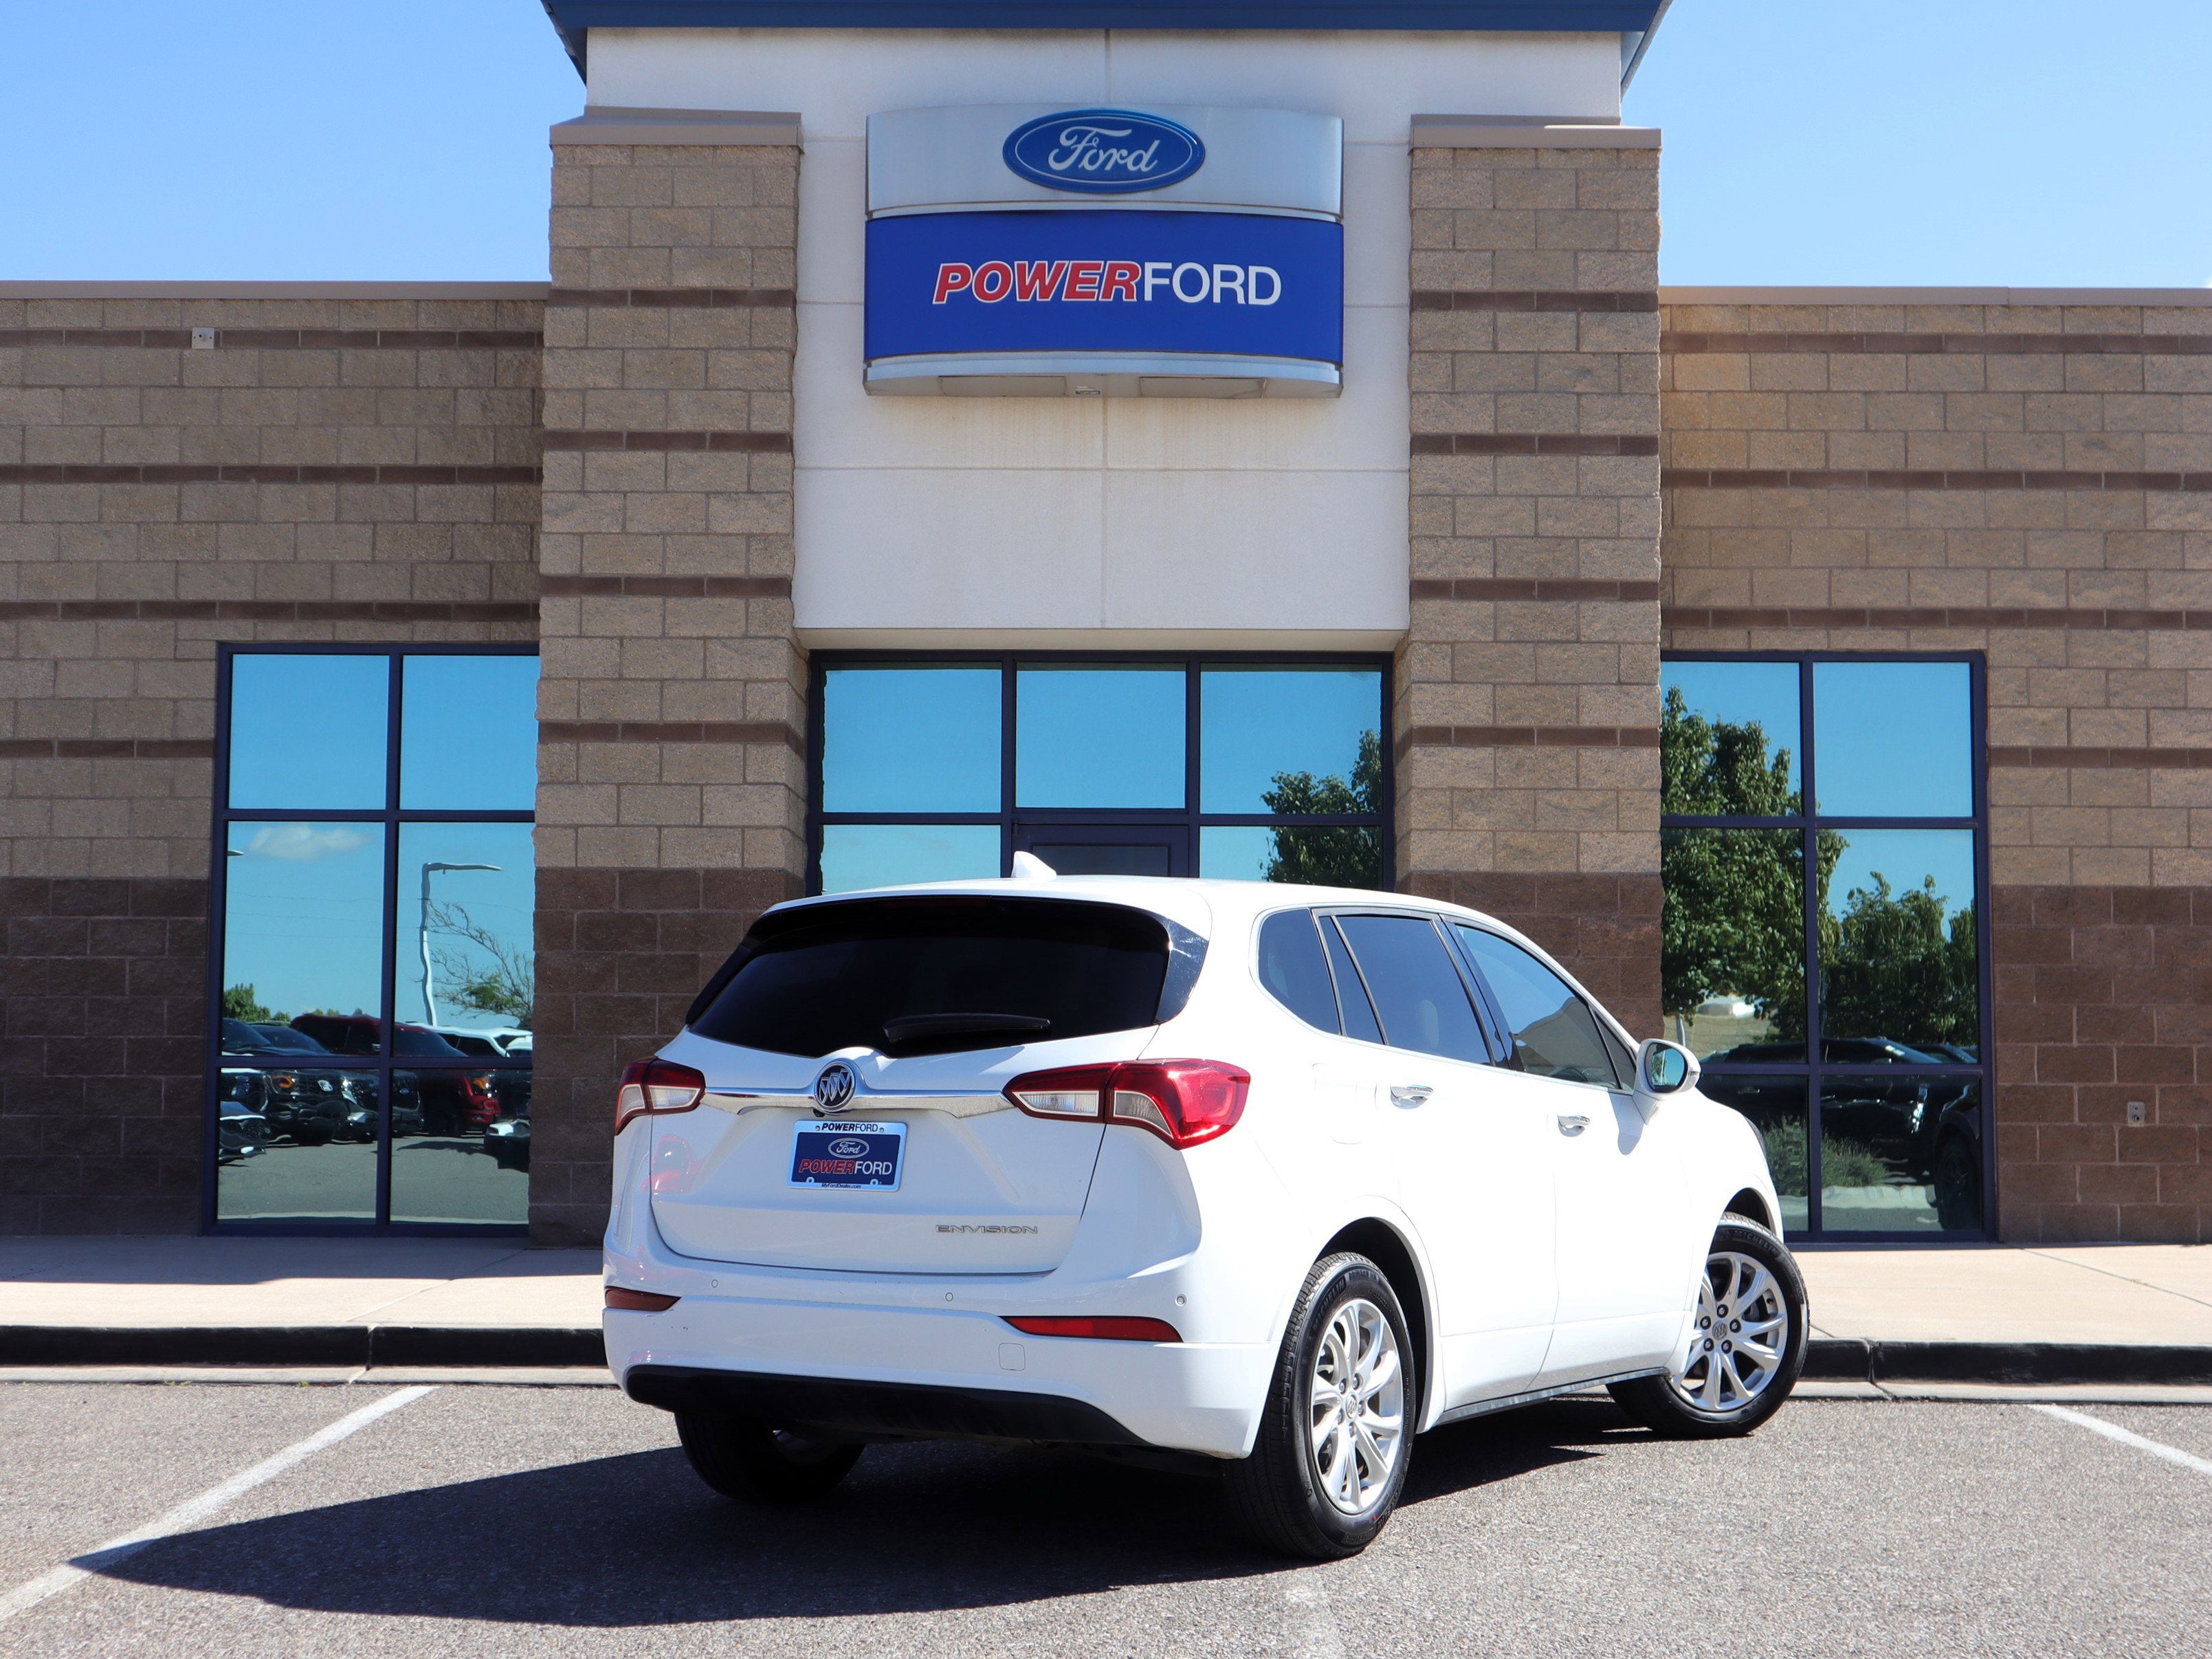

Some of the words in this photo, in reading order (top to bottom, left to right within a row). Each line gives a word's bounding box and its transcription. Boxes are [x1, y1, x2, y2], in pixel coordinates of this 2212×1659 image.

[1048, 126, 1161, 172] Ford
[932, 260, 1282, 305] POWERFORD
[821, 1123, 878, 1132] POWERFORD
[836, 1141, 861, 1154] Ford
[798, 1158, 893, 1175] POWERFORD
[936, 1224, 1038, 1234] ENVISION
[1734, 1229, 1779, 1255] MICHELIN
[1312, 1277, 1345, 1332] MICHELIN
